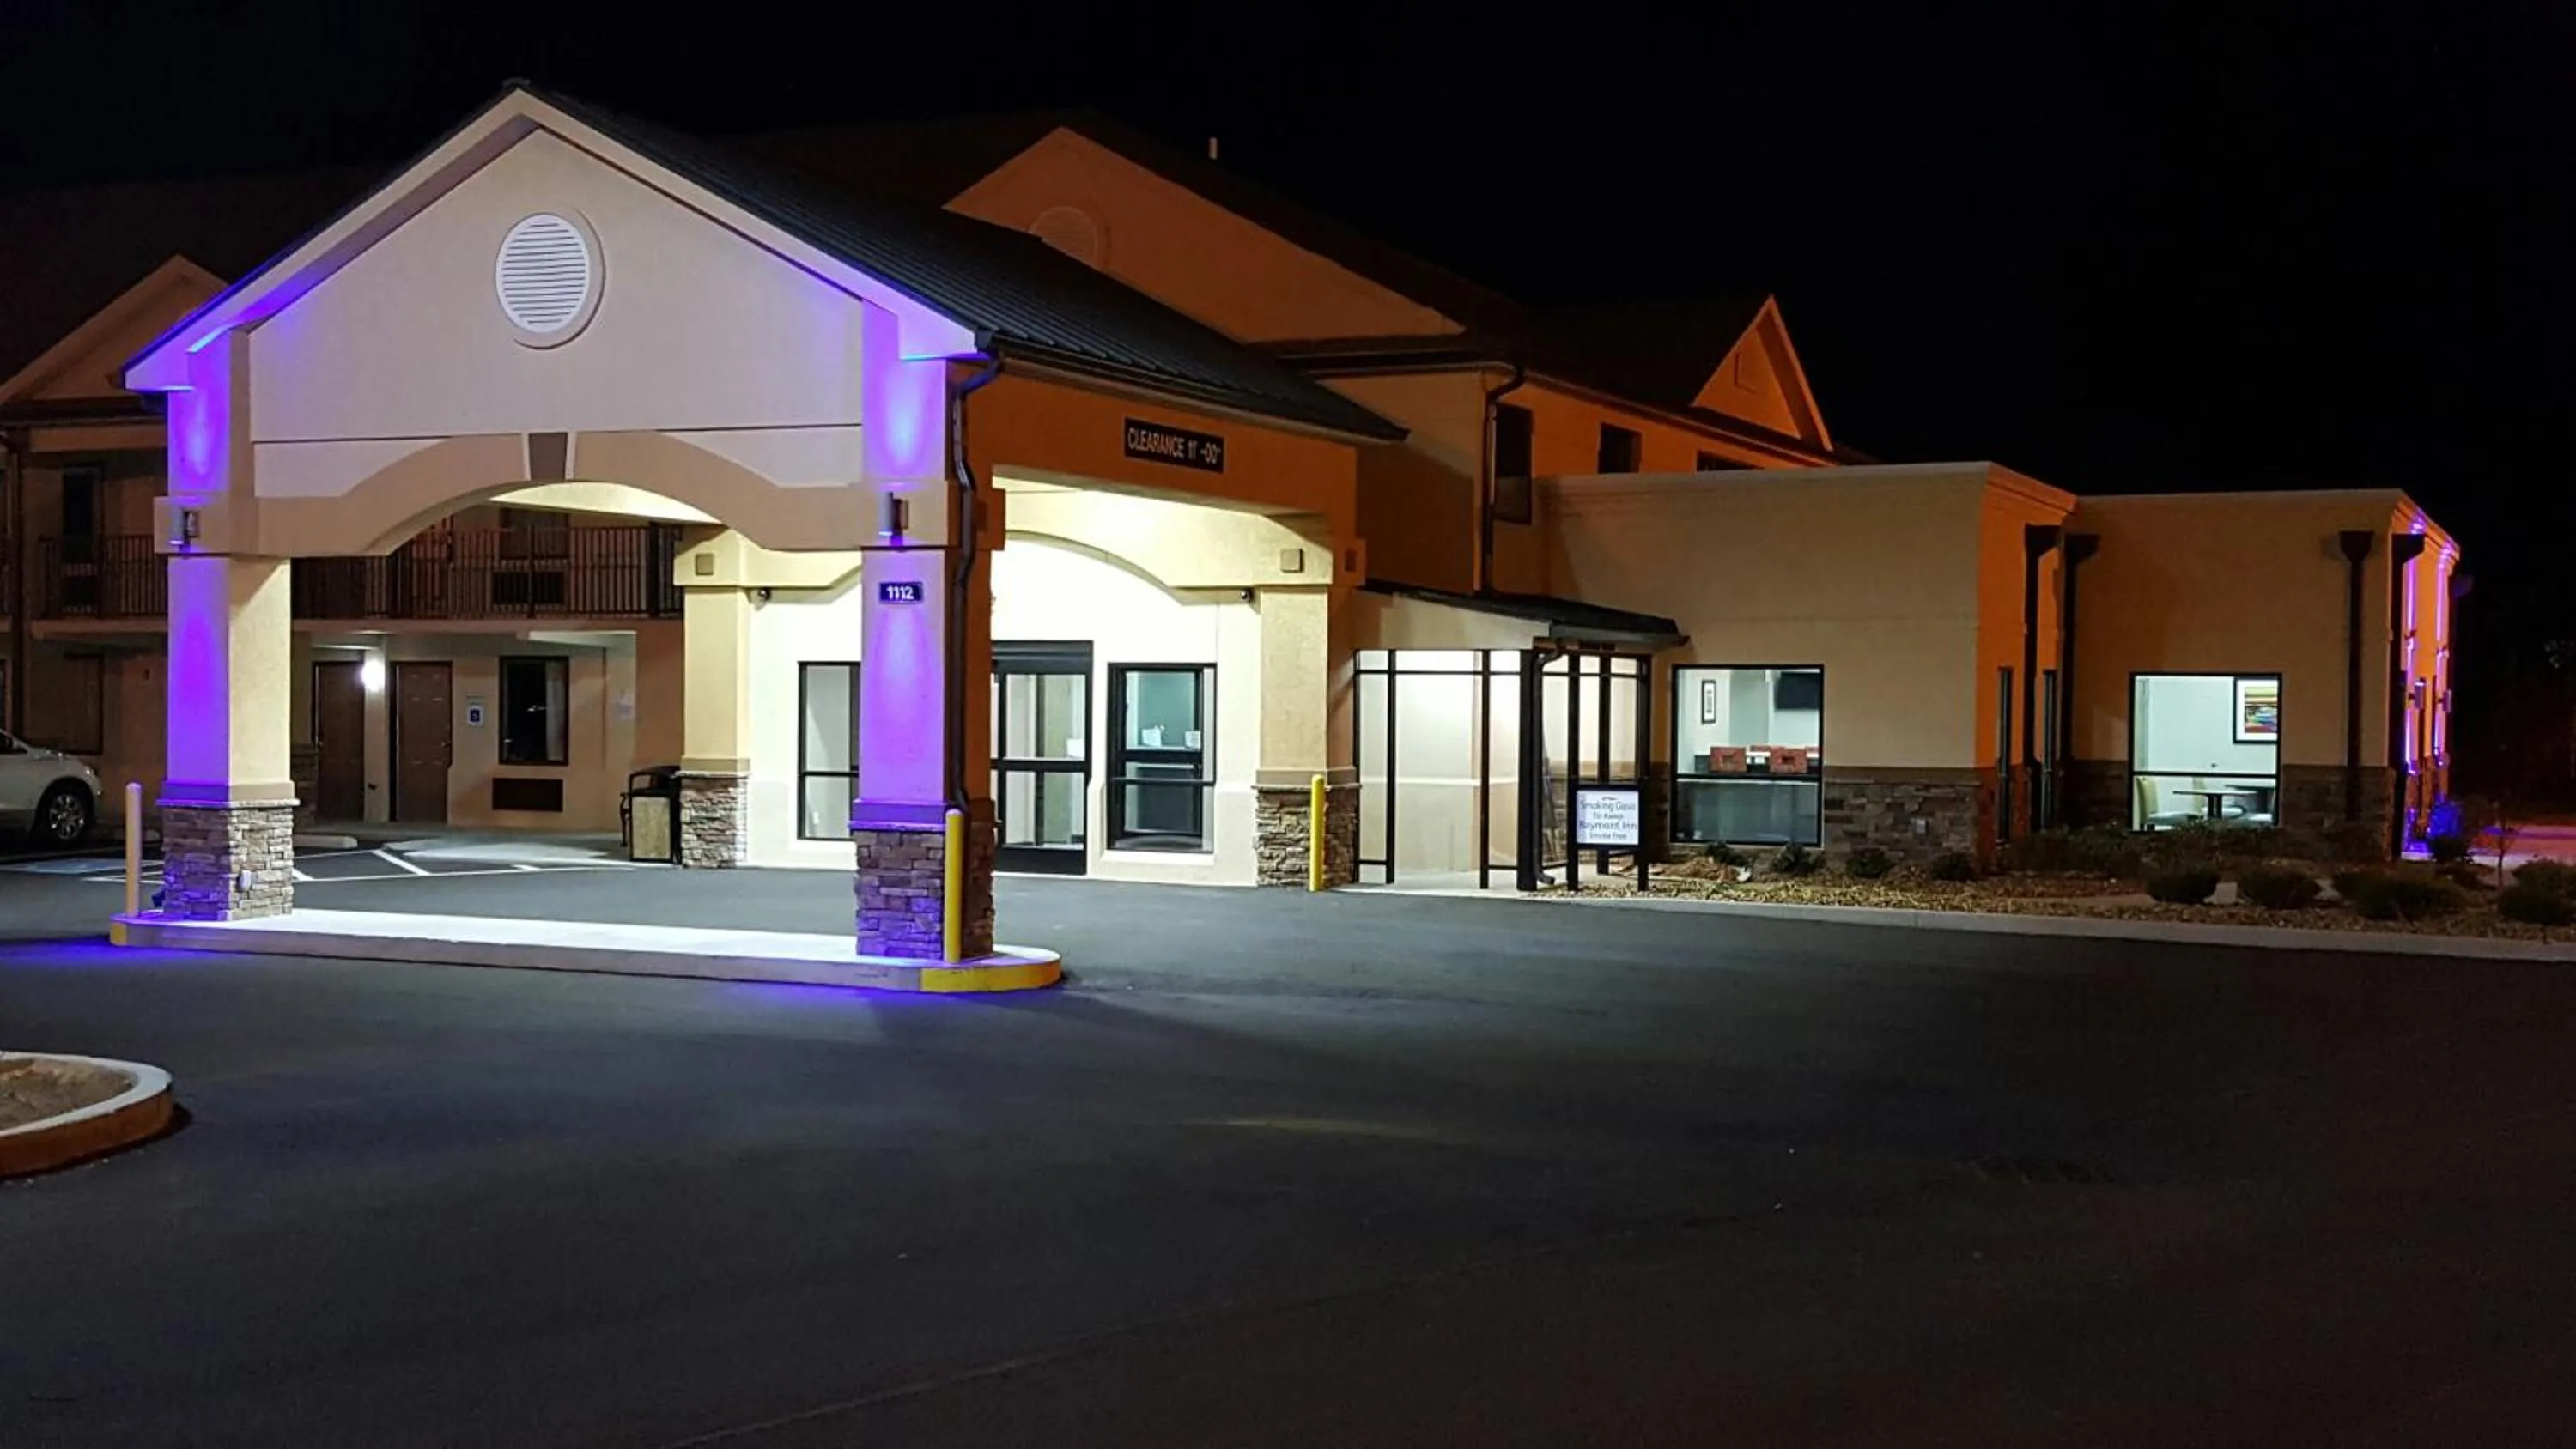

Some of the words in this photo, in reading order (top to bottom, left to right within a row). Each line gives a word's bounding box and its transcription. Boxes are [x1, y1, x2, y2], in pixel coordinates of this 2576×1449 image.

[1127, 427, 1185, 458] CLEARANCE
[886, 585, 914, 600] 1112
[1580, 799, 1613, 812] Smoking
